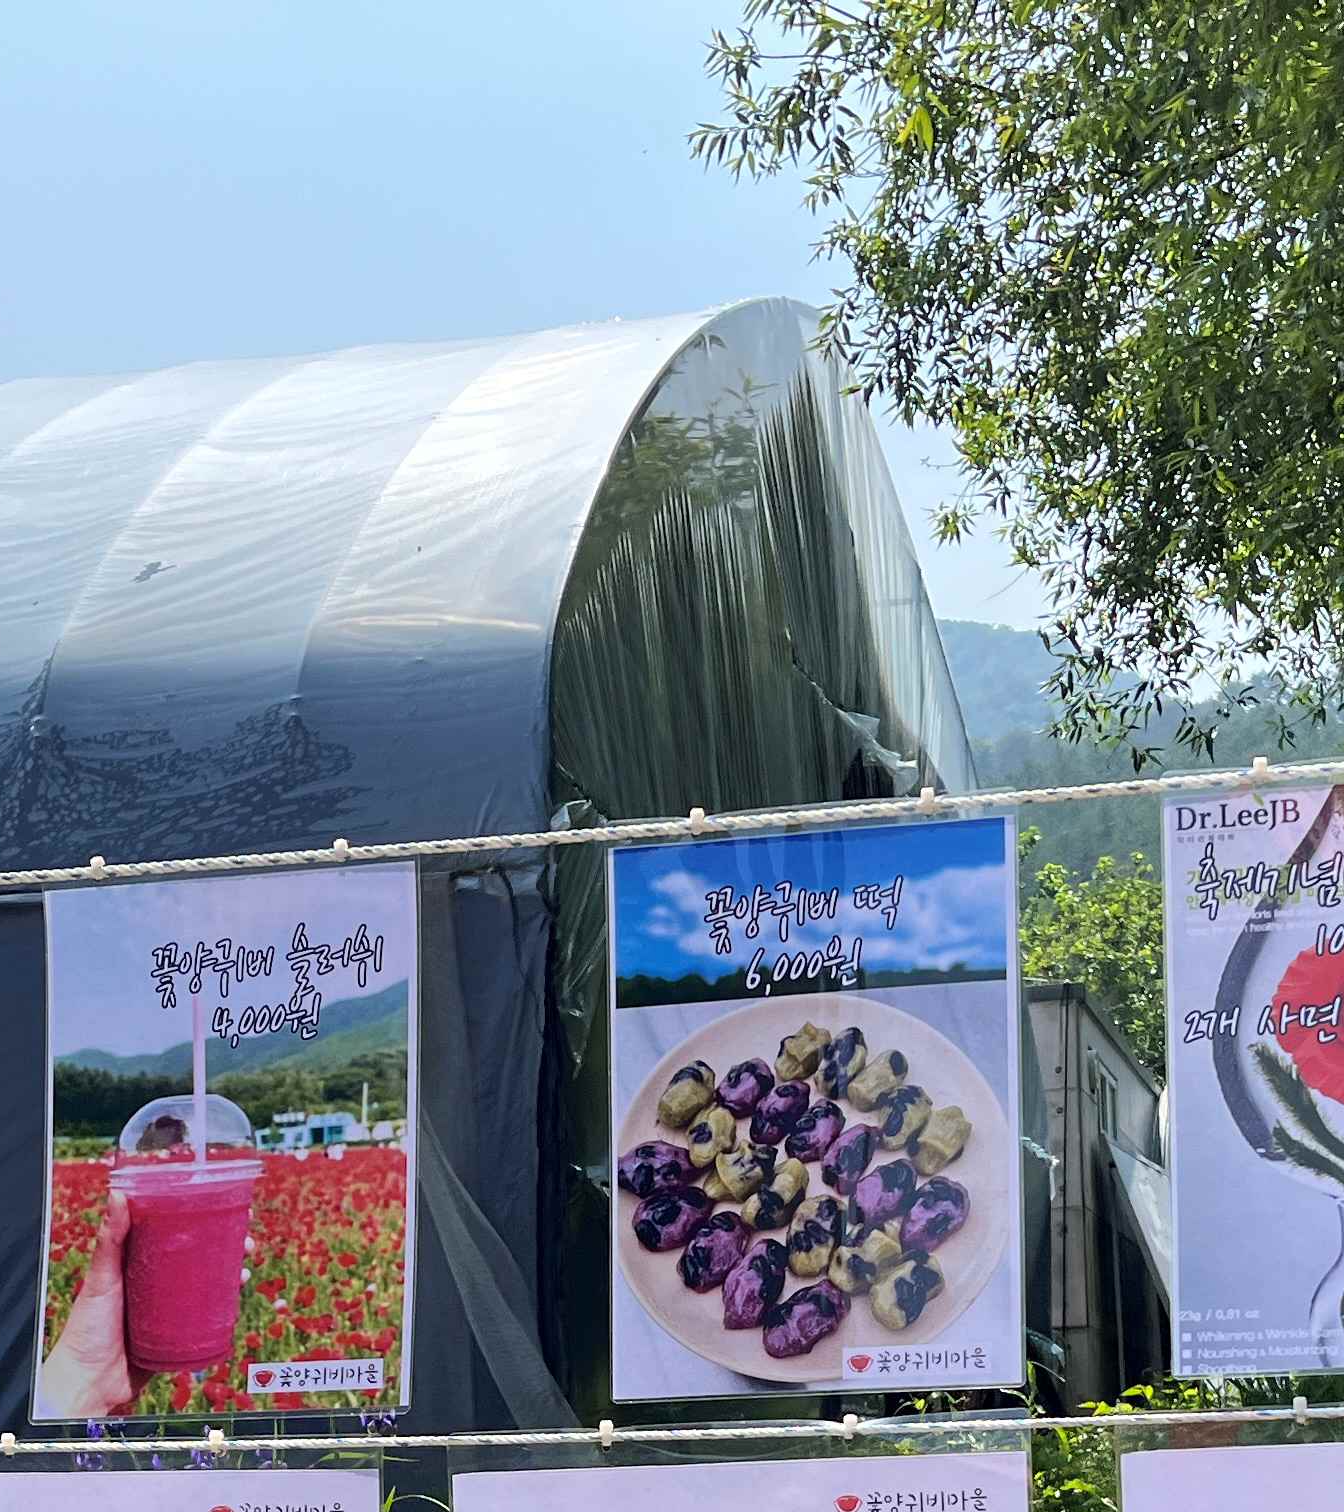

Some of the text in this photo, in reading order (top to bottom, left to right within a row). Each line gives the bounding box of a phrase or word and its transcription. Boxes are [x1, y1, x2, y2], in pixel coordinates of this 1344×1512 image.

[1176, 799, 1300, 831] Dr.LeeJB
[703, 875, 904, 956] 꽃양귀비 떡
[150, 922, 385, 1009] 꽃양귀비 슬러쉬
[745, 934, 864, 997] 6,000원
[211, 993, 322, 1048] 4,000원
[1183, 1006, 1241, 1044] 2개
[1257, 997, 1341, 1043] 사면
[278, 1364, 379, 1387] 꽃양귀비마을
[877, 1349, 987, 1373] 꽃양귀비마을
